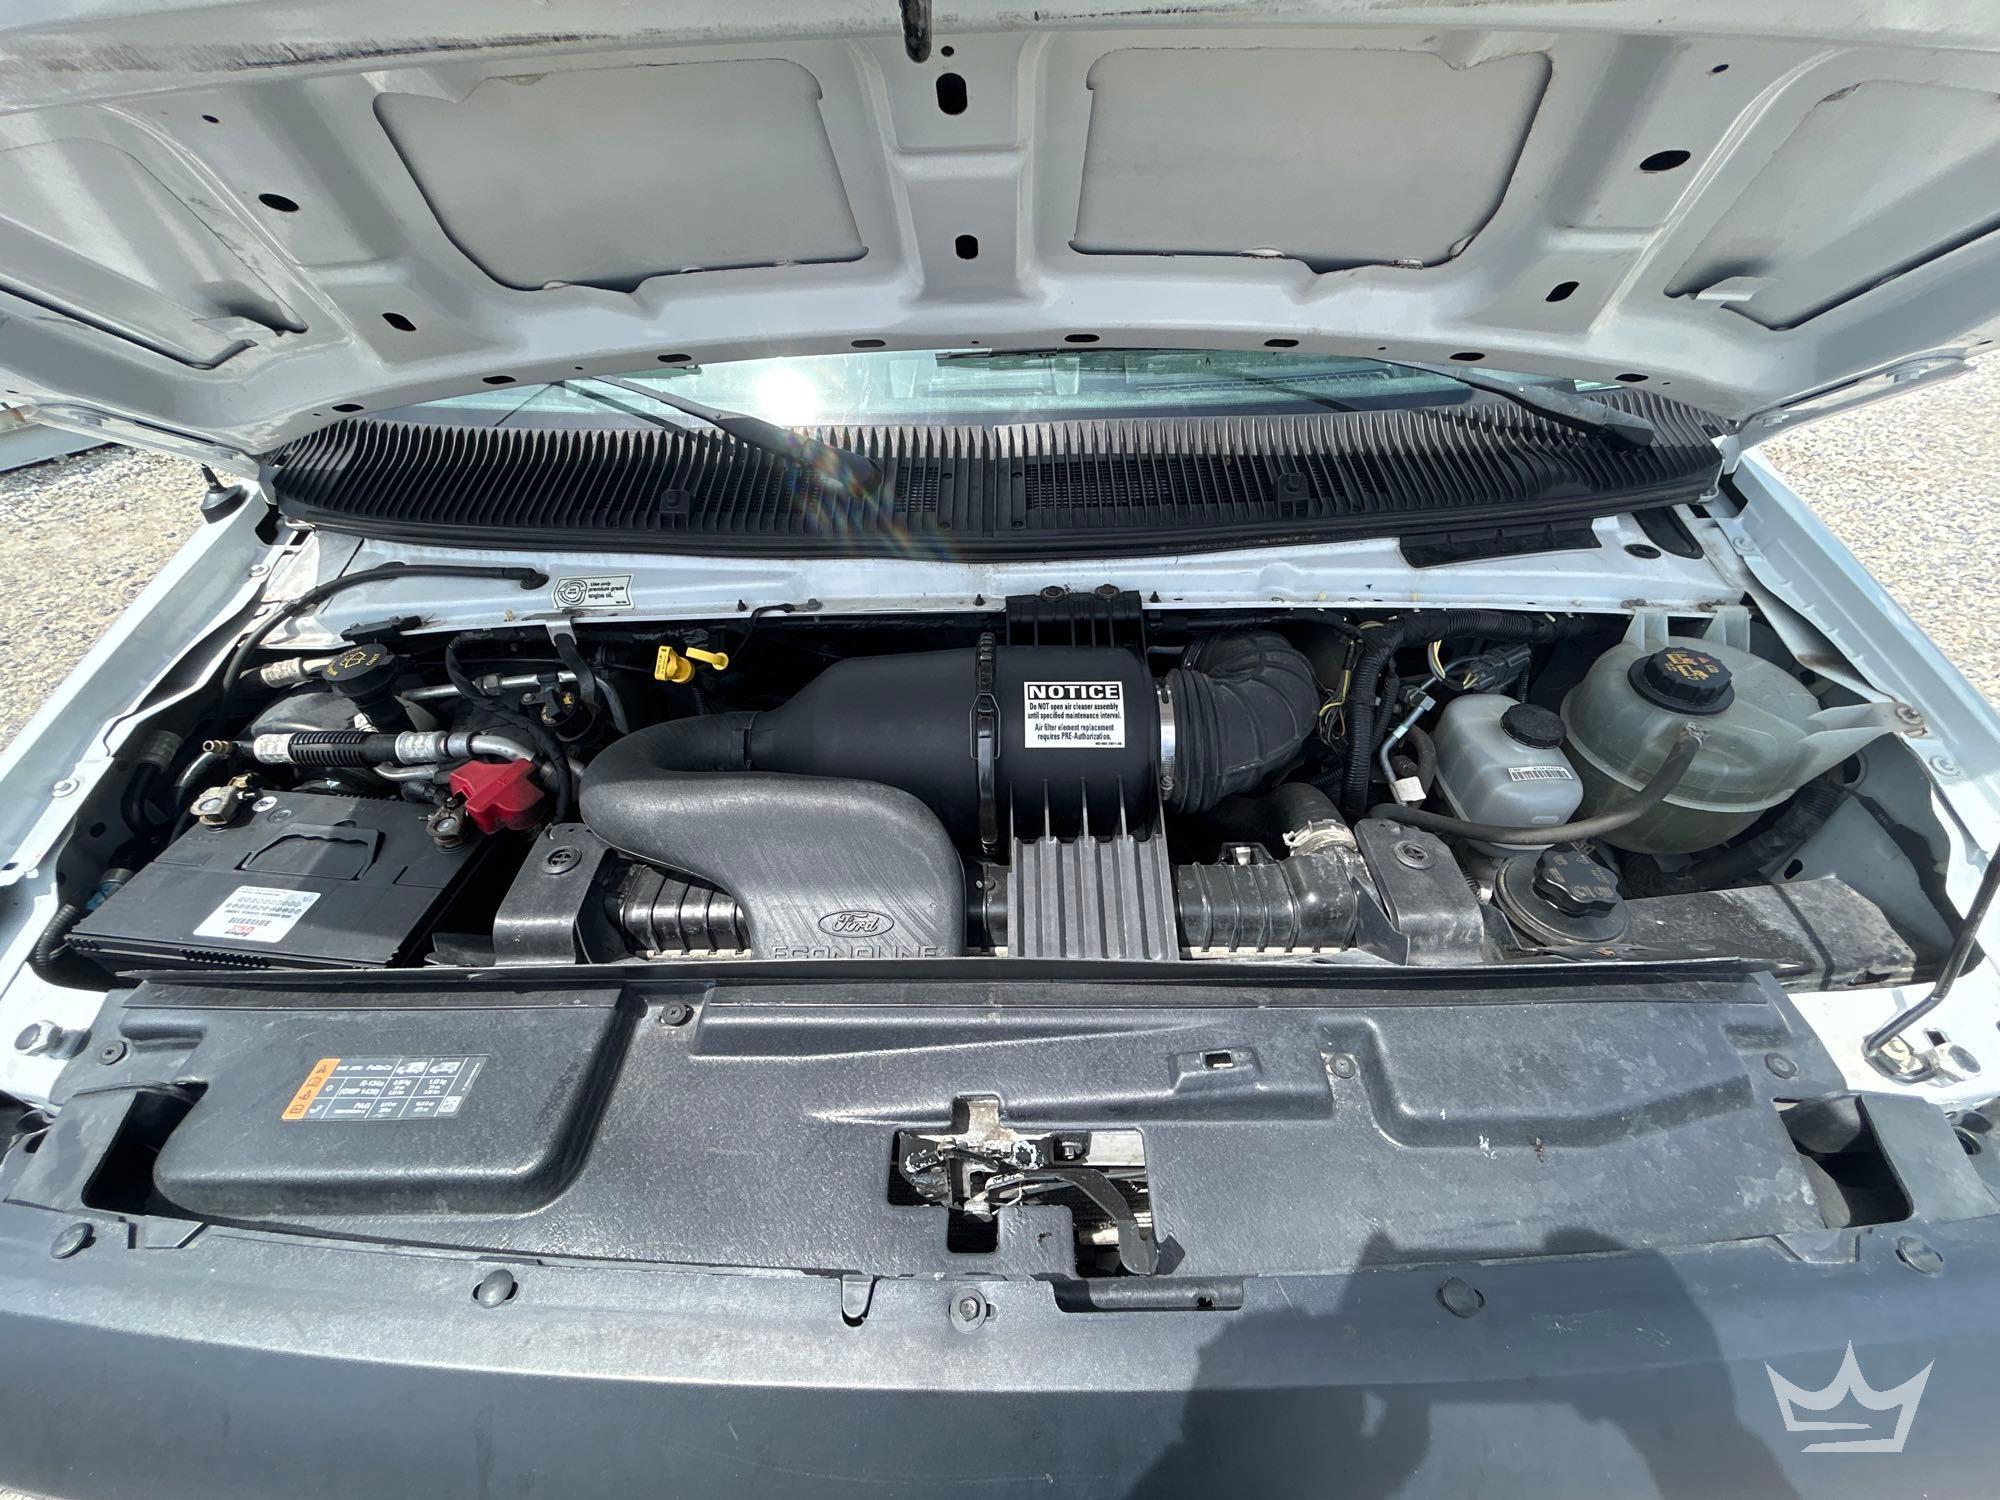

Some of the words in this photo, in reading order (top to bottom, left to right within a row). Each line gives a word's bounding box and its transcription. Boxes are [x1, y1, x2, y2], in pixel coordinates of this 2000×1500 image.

[1029, 685, 1119, 699] NOTICE
[1064, 702, 1072, 710] air
[1073, 702, 1093, 710] cleaner
[1094, 702, 1119, 711] assembly
[1040, 711, 1064, 720] specified
[1065, 711, 1099, 719] maintenance
[1100, 711, 1121, 719] interval.
[1035, 723, 1043, 731] Air
[1044, 723, 1057, 731] filter
[1058, 723, 1079, 731] element
[1080, 723, 1114, 733] replacement
[1038, 734, 1060, 742] requires
[1061, 731, 1111, 741] PRE-Authorization.
[832, 913, 880, 932] Ford
